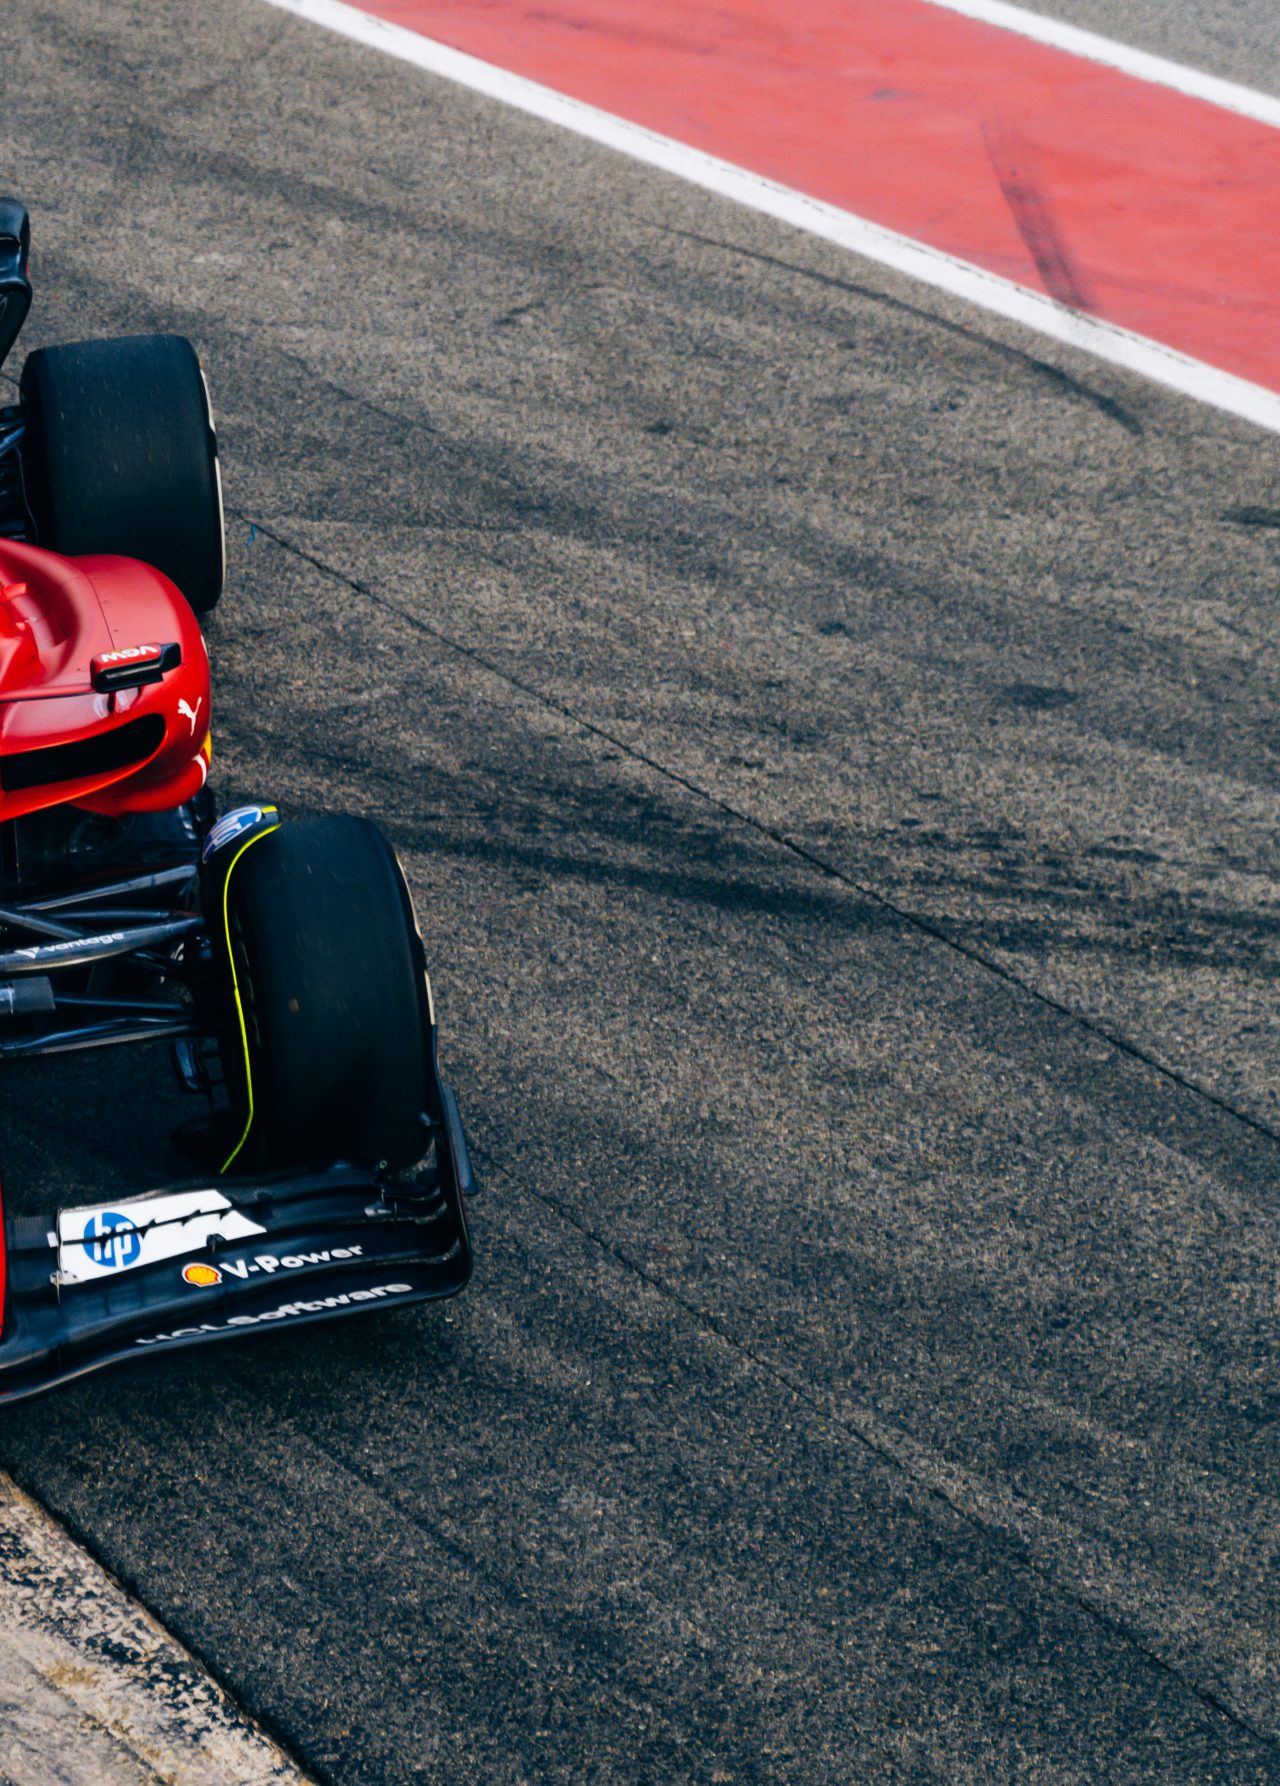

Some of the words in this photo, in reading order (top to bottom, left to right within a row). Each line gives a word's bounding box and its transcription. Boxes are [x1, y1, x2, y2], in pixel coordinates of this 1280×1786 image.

[100, 645, 158, 663] VGW
[93, 1212, 133, 1267] hp
[219, 1243, 366, 1280] V-Power
